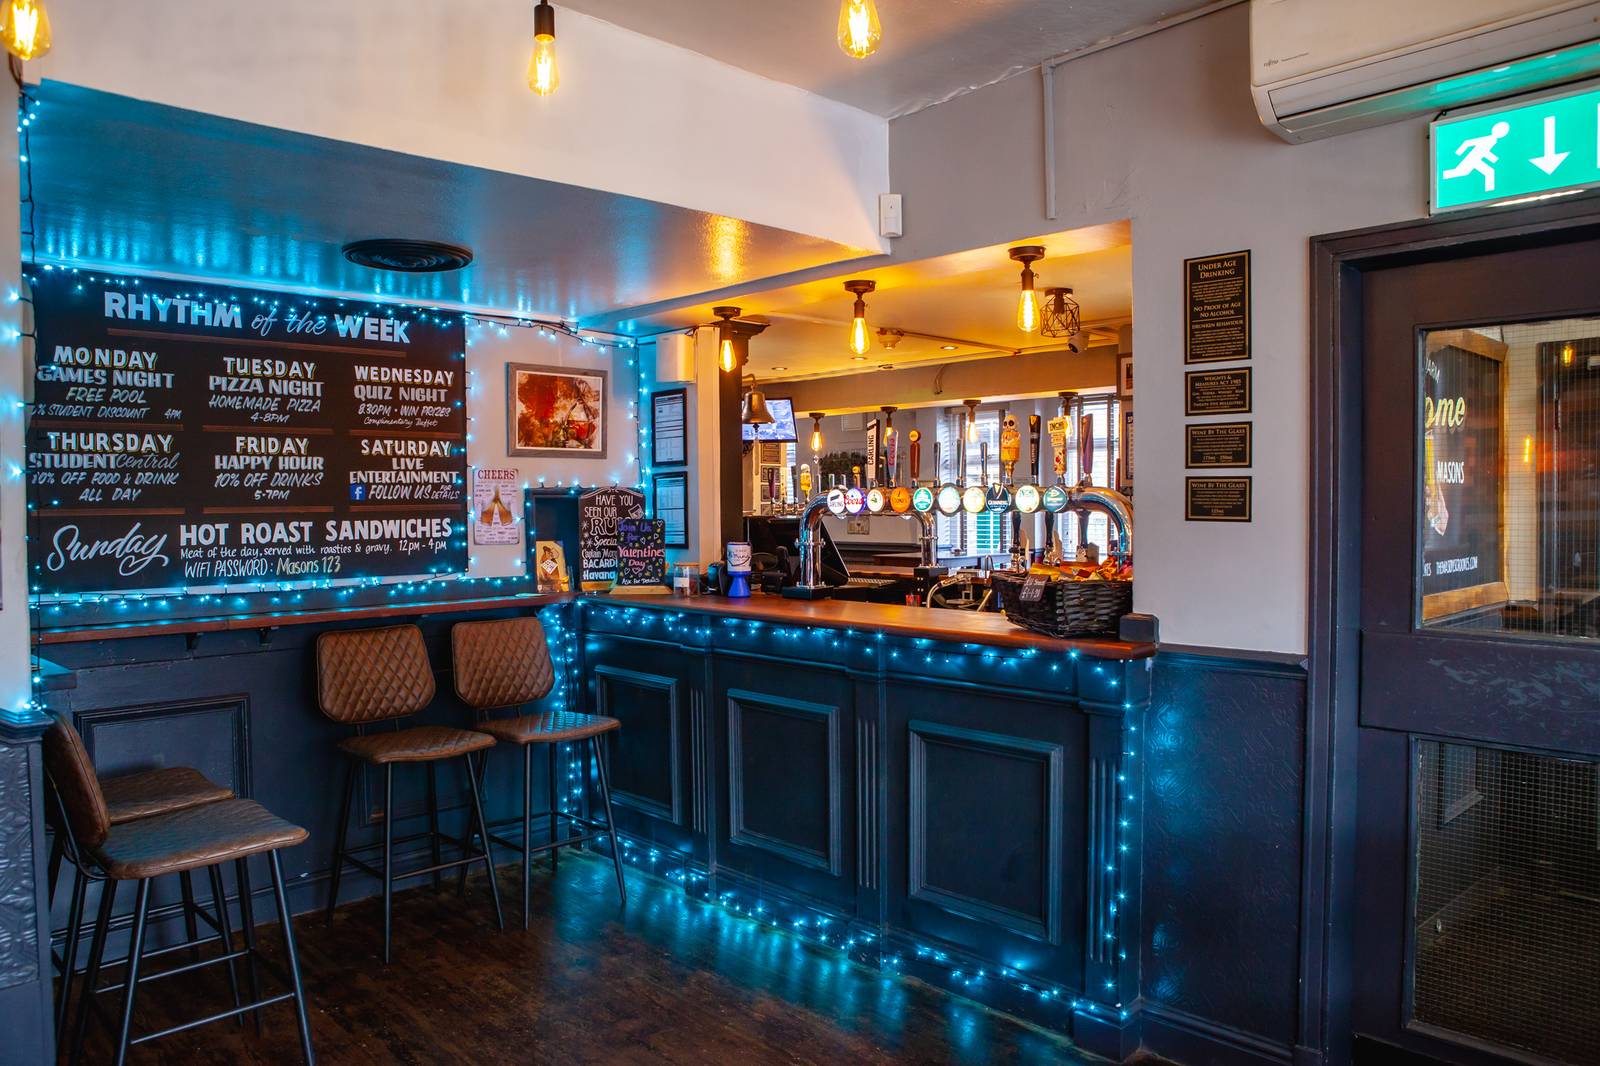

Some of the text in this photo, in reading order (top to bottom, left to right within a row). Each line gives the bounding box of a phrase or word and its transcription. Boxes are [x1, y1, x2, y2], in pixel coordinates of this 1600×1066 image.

[104, 291, 410, 344] RHYTHM of the WEEK
[53, 345, 158, 370] MONDAY
[223, 356, 316, 380] TUESDAY
[354, 365, 454, 386] WEDNESDAY
[37, 365, 175, 388] GAMES NIGHT
[209, 375, 325, 398] PIZZA NIGHT
[354, 385, 449, 402] QUIZ NIGHT
[66, 387, 147, 404] FREE POOL
[208, 395, 321, 412] HOMEMADE PIZZA
[48, 404, 95, 418] STUDENT
[97, 406, 150, 420] DISCOUNT
[250, 412, 290, 424] 4-8PM
[400, 404, 420, 417] WIN
[363, 416, 414, 428] Complimentary
[47, 431, 174, 453] THURSDAY
[236, 436, 310, 456] FRIDAY
[361, 439, 452, 456] SATURDAY
[867, 434, 876, 466] CARLING
[29, 452, 180, 470] STUDENT Central
[215, 455, 324, 470] HAPPY HOUR
[392, 457, 424, 470] LIVE
[61, 472, 87, 485] OFF
[91, 472, 120, 485] FOOD
[124, 473, 130, 485] &
[134, 472, 180, 485] DRINK
[214, 472, 324, 488] 10% OFF DRINKS
[350, 471, 460, 484] ENTERTAINMENT
[477, 469, 515, 481] CHEERS
[1436, 460, 1465, 484] MASONS
[79, 488, 142, 501] ALL DAY
[368, 485, 412, 500] FOLLOW
[413, 484, 431, 499] US
[431, 489, 460, 500] DETAILS
[595, 495, 634, 506] HAVE YOU
[584, 506, 618, 518] SEEN OUR
[47, 522, 169, 577] Sunday
[180, 523, 230, 546] HOT
[241, 521, 313, 545] ROAST
[325, 518, 452, 542] SANDWICHES
[180, 548, 203, 560] Meat
[207, 546, 218, 559] of
[220, 546, 237, 558] the
[263, 545, 292, 556] served
[296, 544, 316, 555] with
[320, 543, 352, 554] roasties
[354, 543, 362, 553] &
[581, 549, 602, 560] Captain
[617, 545, 665, 558] Valentines
[184, 561, 210, 578] WIFI
[276, 557, 319, 575] Masons
[322, 556, 342, 573] 123
[583, 558, 618, 569] BACARDI
[628, 559, 646, 571] Day
[583, 569, 616, 580] Havana
